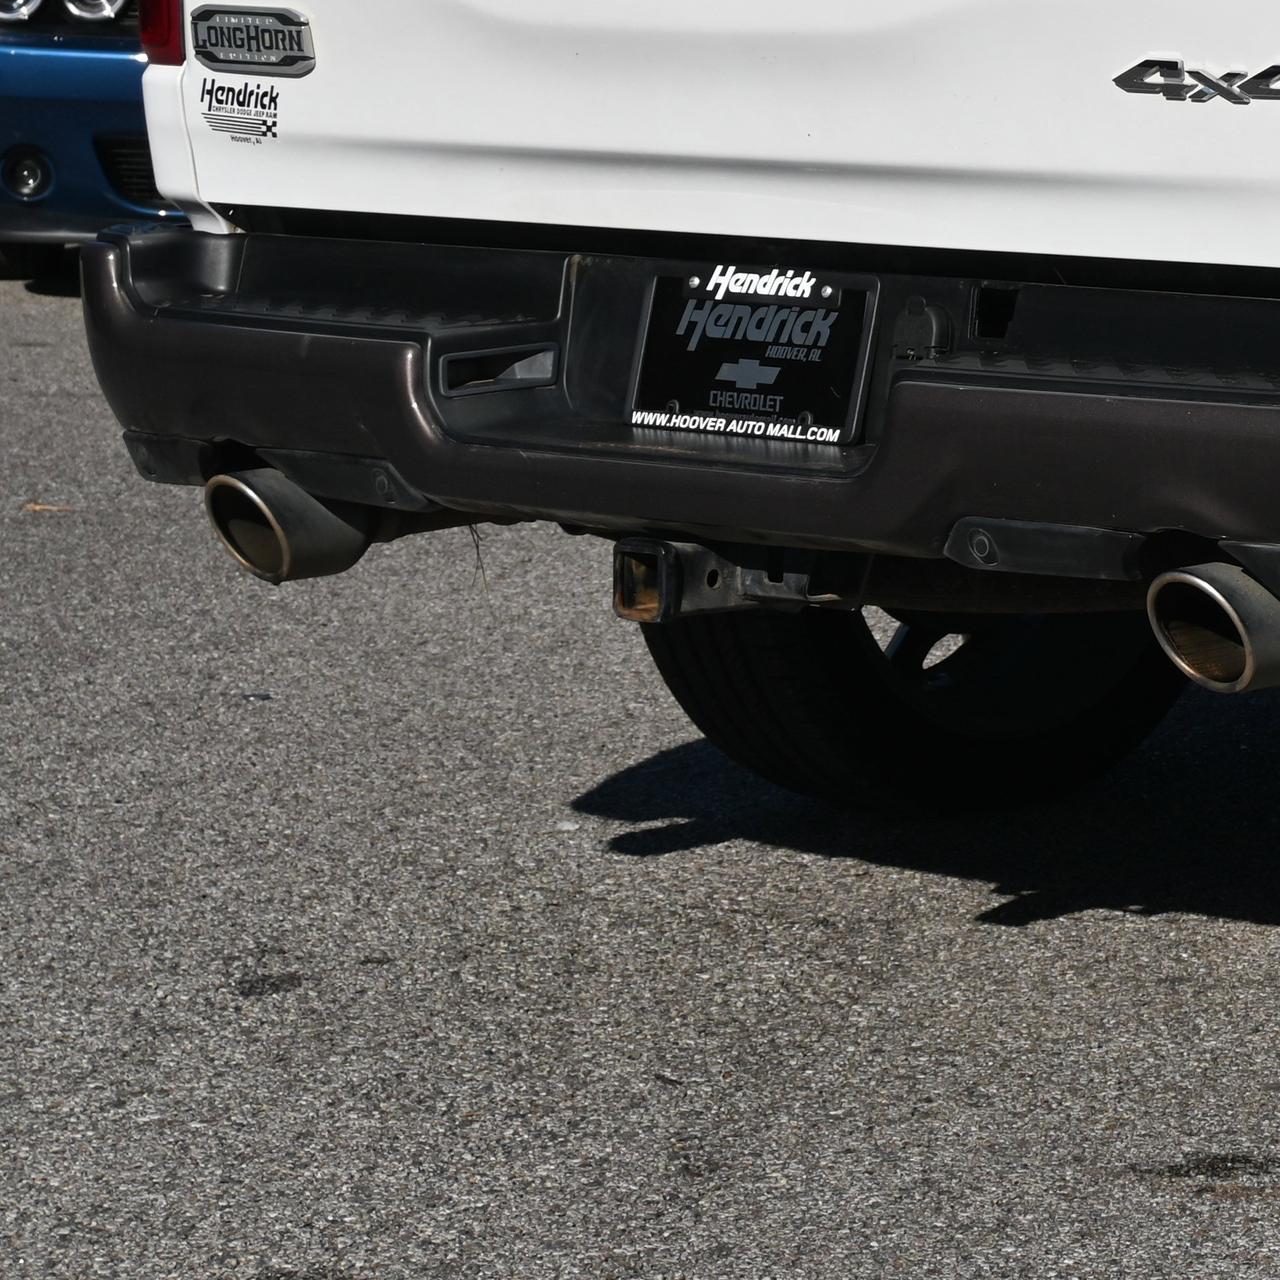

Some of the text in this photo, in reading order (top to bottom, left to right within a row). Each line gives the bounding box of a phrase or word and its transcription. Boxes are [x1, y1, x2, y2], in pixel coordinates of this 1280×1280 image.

[200, 77, 279, 112] Hendrick
[212, 105, 278, 119] CHRYSLER DODGE JEEP RAM
[706, 265, 816, 300] Hendrick
[676, 298, 839, 351] Hendrick
[764, 344, 822, 362] HOOVER, AL
[709, 390, 783, 412] CHEVROLET
[632, 411, 726, 432] WWW.HOOVER
[726, 420, 765, 435] AUTO
